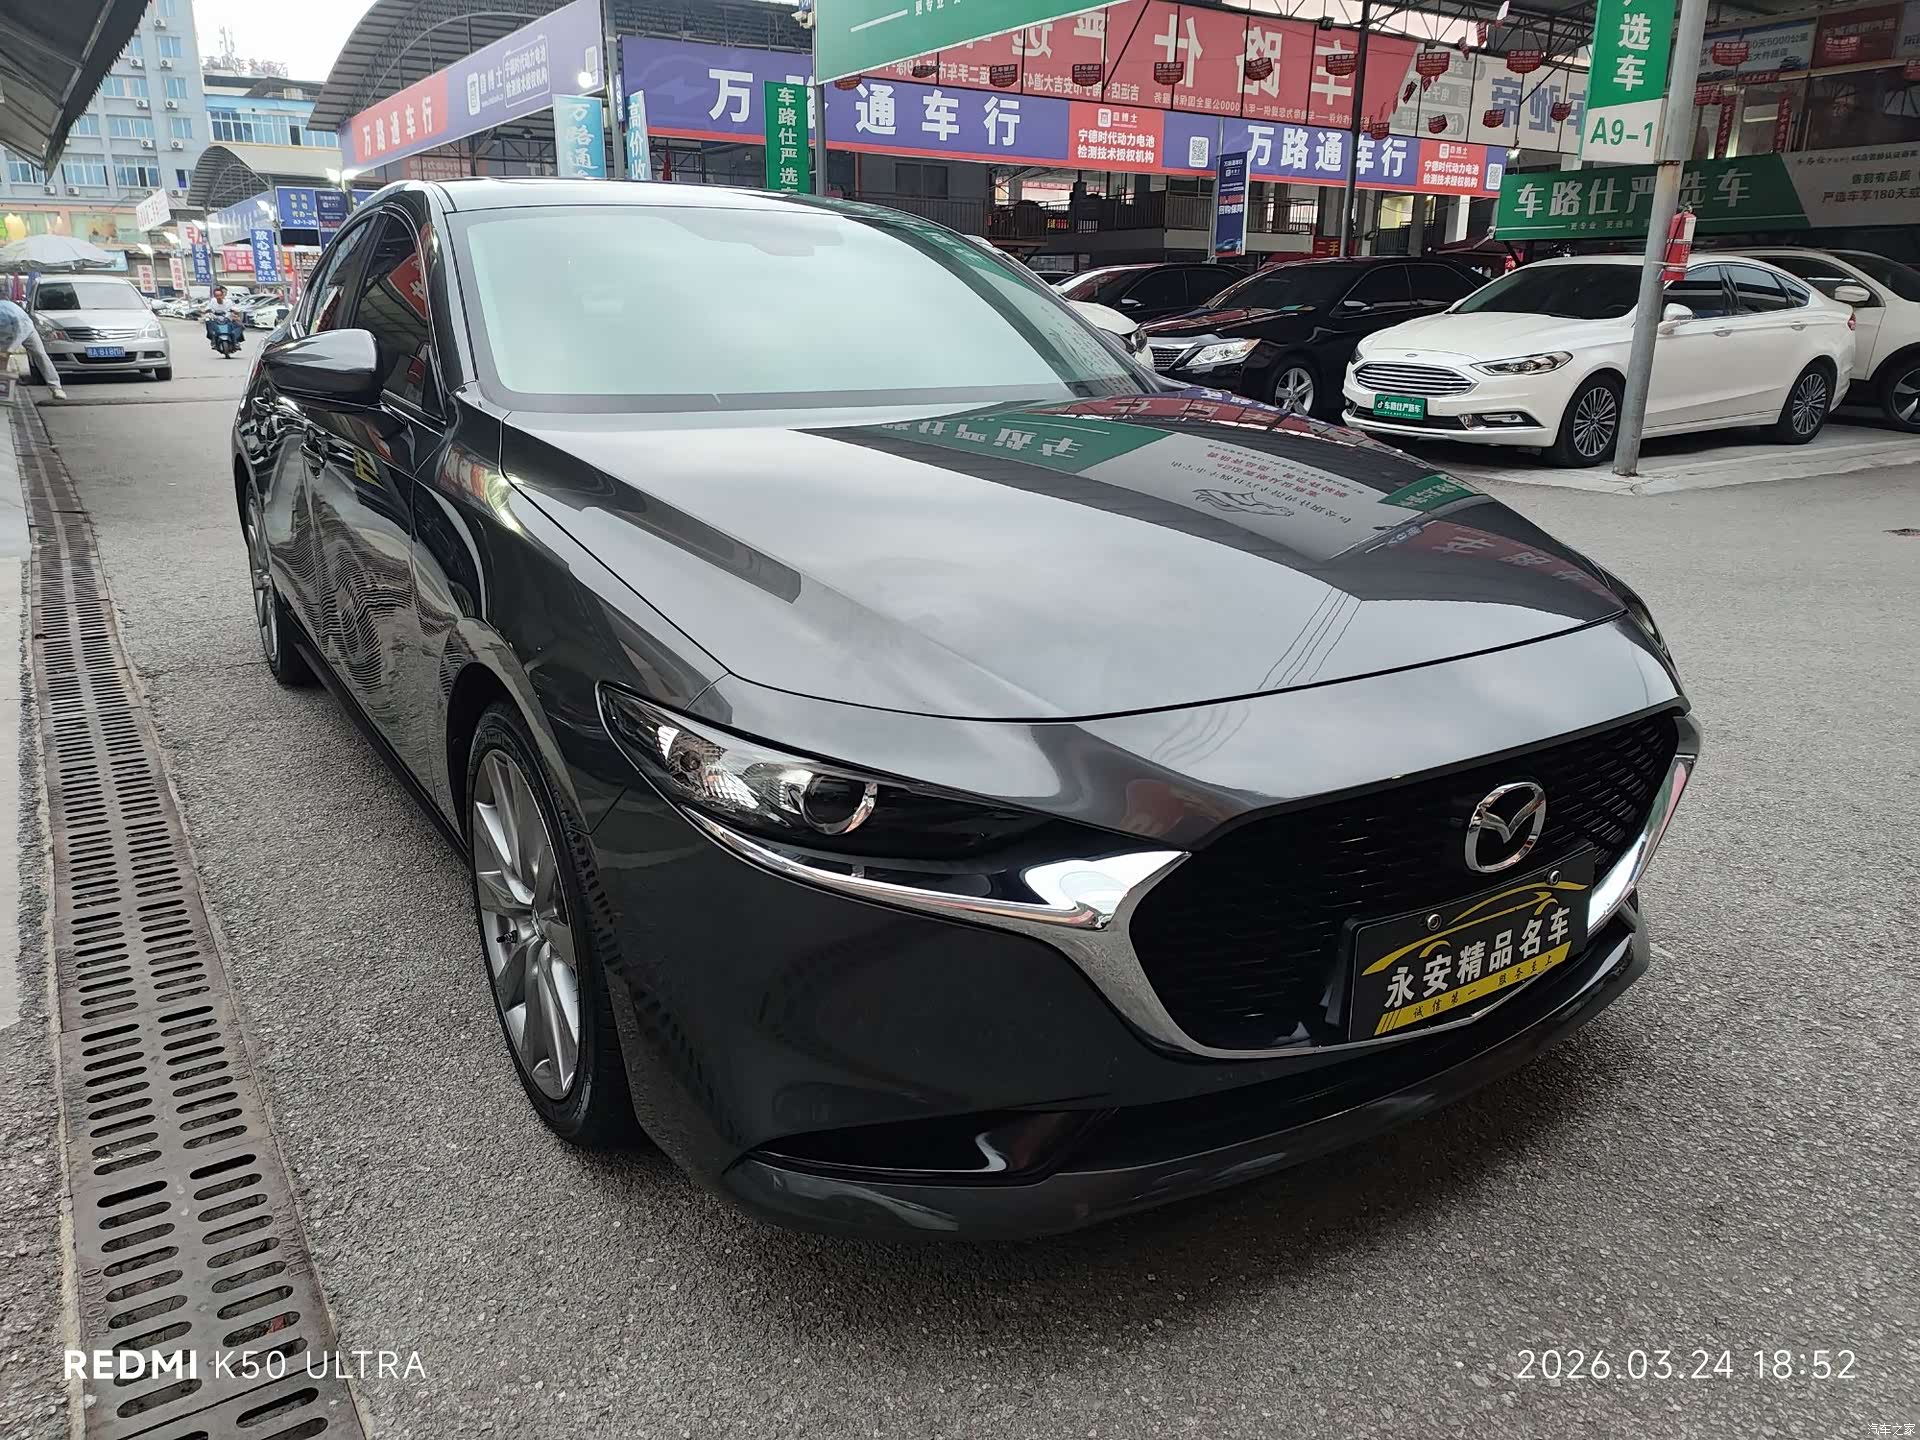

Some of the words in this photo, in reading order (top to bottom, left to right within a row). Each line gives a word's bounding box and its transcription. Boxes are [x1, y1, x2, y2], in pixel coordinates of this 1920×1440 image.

[1613, 0, 1651, 91] 选车
[363, 95, 432, 157] 万路通车行
[567, 103, 599, 177] 万路通
[777, 87, 799, 192] 车路仕严选
[1078, 129, 1155, 148] 宁德时代动力电池
[1590, 117, 1654, 148] A9-1
[1077, 145, 1155, 164] 检测技术授权机构
[1246, 124, 1407, 179] 万路通车行
[1424, 160, 1480, 175] 宁德时代动力电池
[1423, 173, 1478, 188] 检测技术授权机构
[1384, 907, 1571, 1009] 永安精品名车
[1497, 955, 1553, 987] 服务至上
